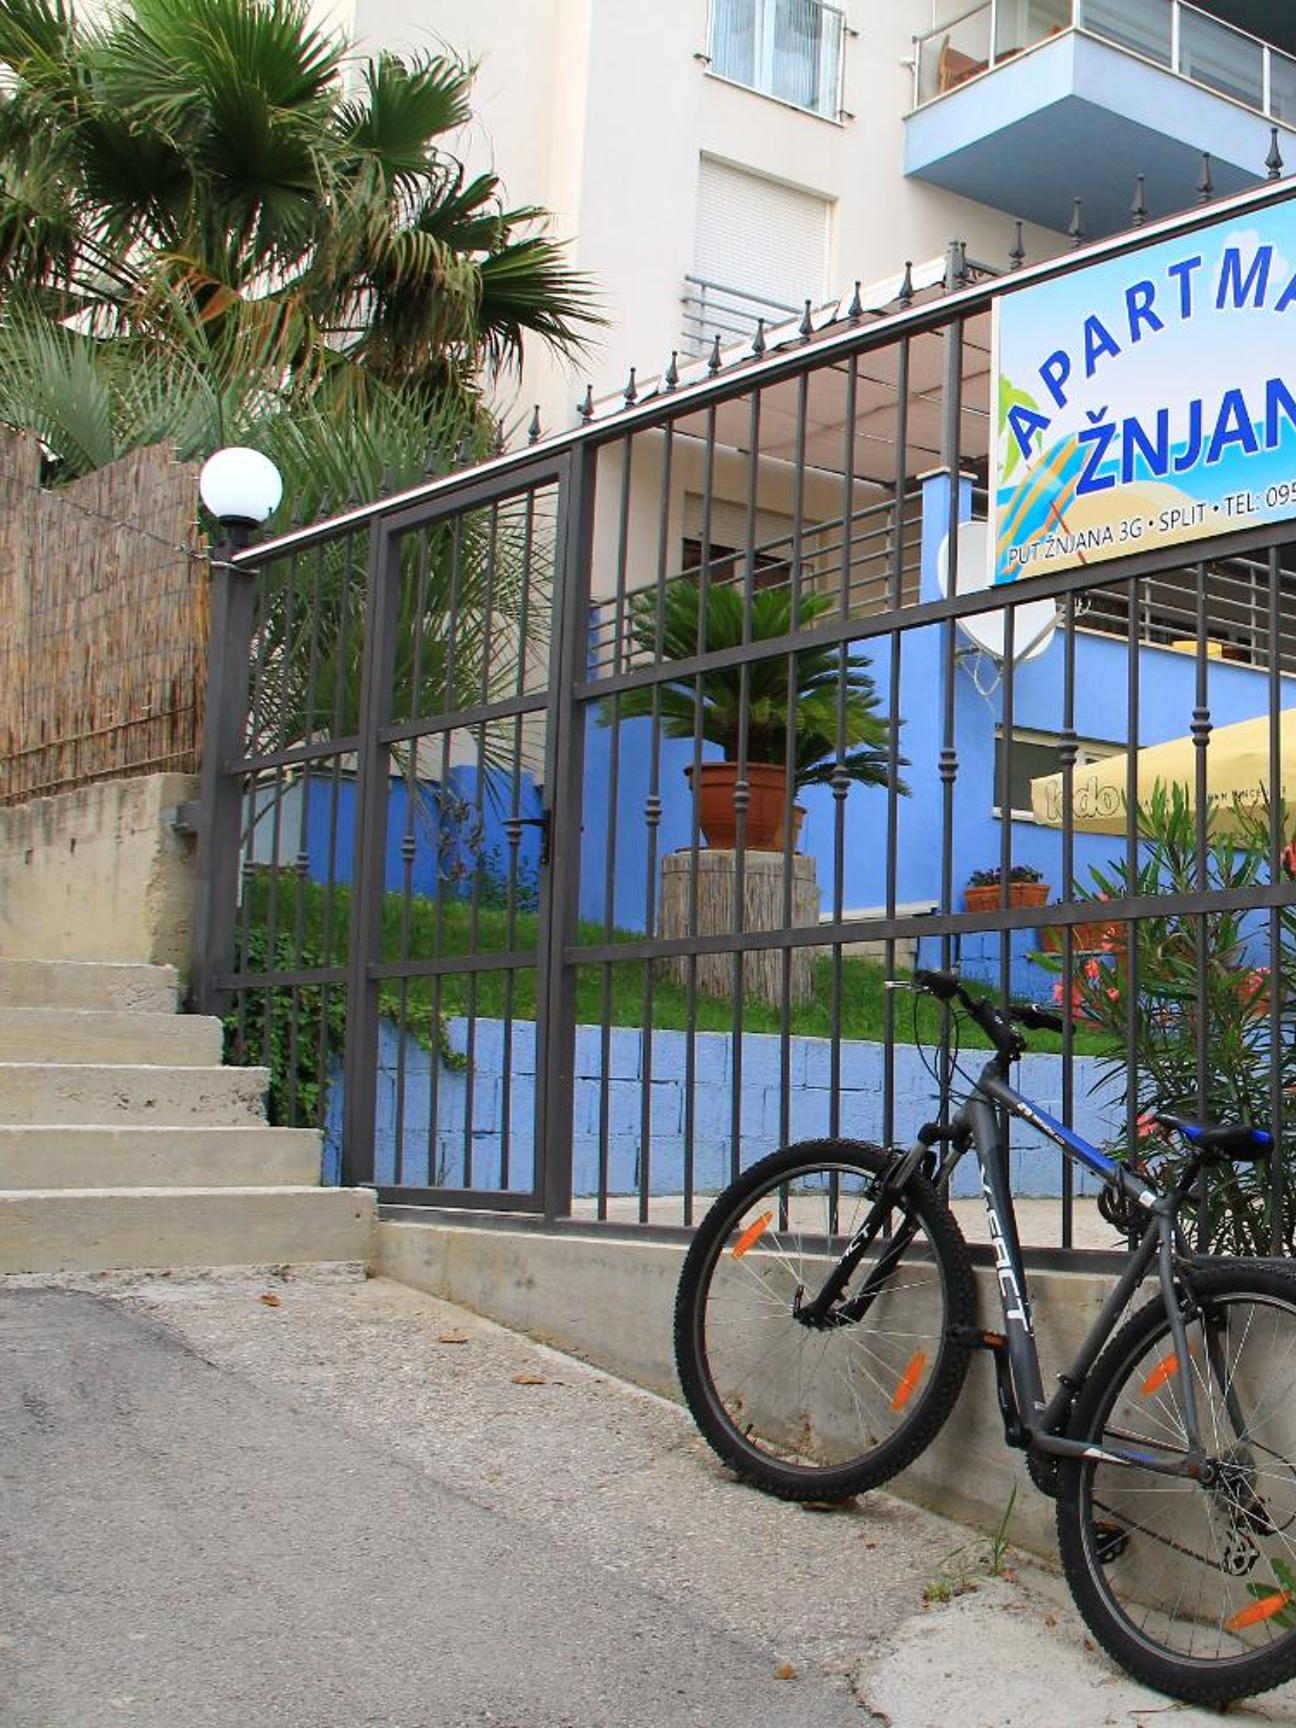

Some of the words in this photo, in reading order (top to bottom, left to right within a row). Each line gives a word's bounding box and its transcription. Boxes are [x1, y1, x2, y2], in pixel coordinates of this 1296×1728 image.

[1008, 545, 1043, 567] PUT
[1045, 525, 1114, 559] ŽNJANA
[1119, 518, 1143, 542] 3G
[1158, 503, 1206, 532] SPLIT
[1224, 493, 1260, 516] TEL:
